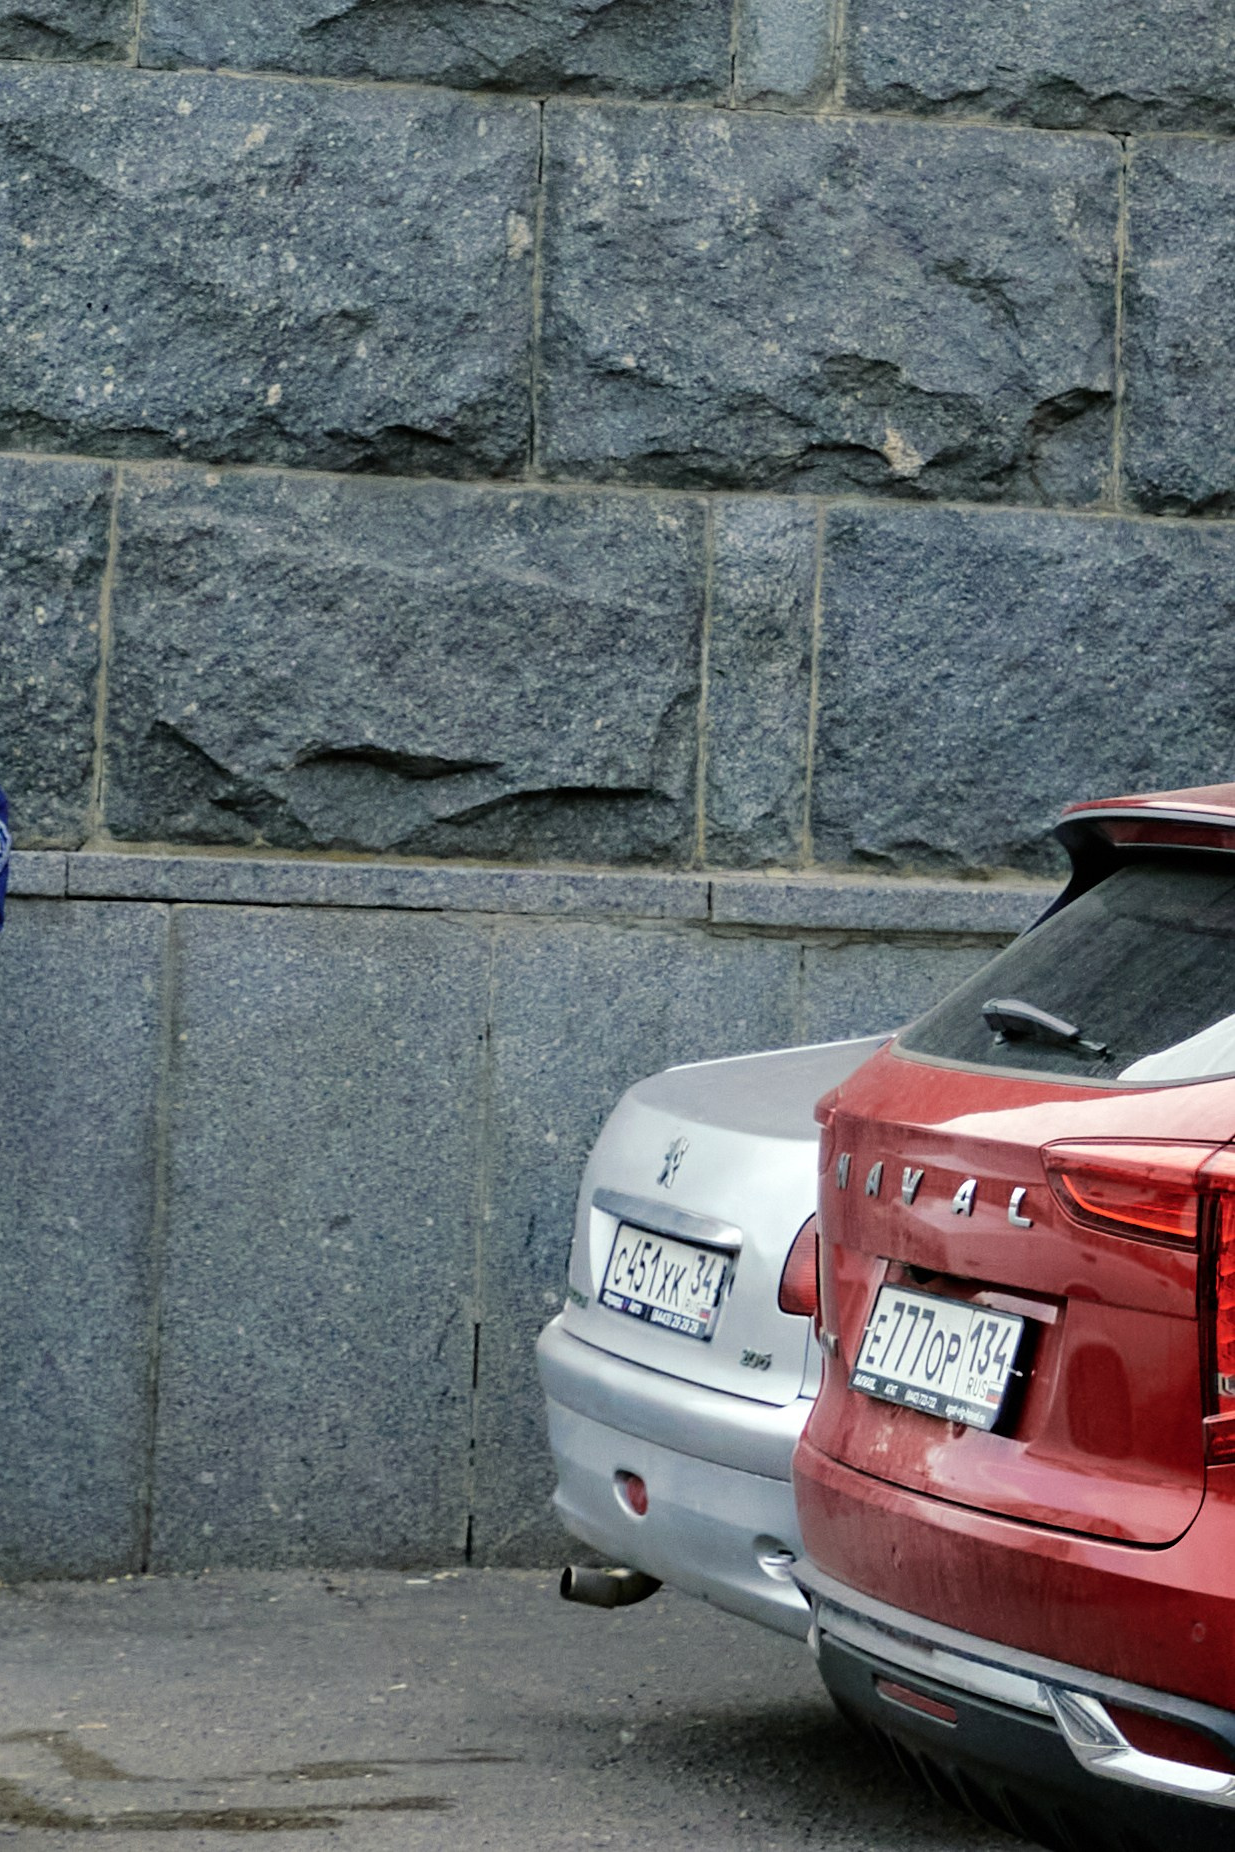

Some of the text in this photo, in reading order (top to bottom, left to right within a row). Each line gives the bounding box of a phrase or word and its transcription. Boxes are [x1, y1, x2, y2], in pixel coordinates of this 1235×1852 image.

[837, 1152, 1033, 1228] HAVAL
[614, 1239, 716, 1307] С451ХК 34
[866, 1301, 1011, 1385] Е777ОР 134
[967, 1377, 988, 1399] RUS
